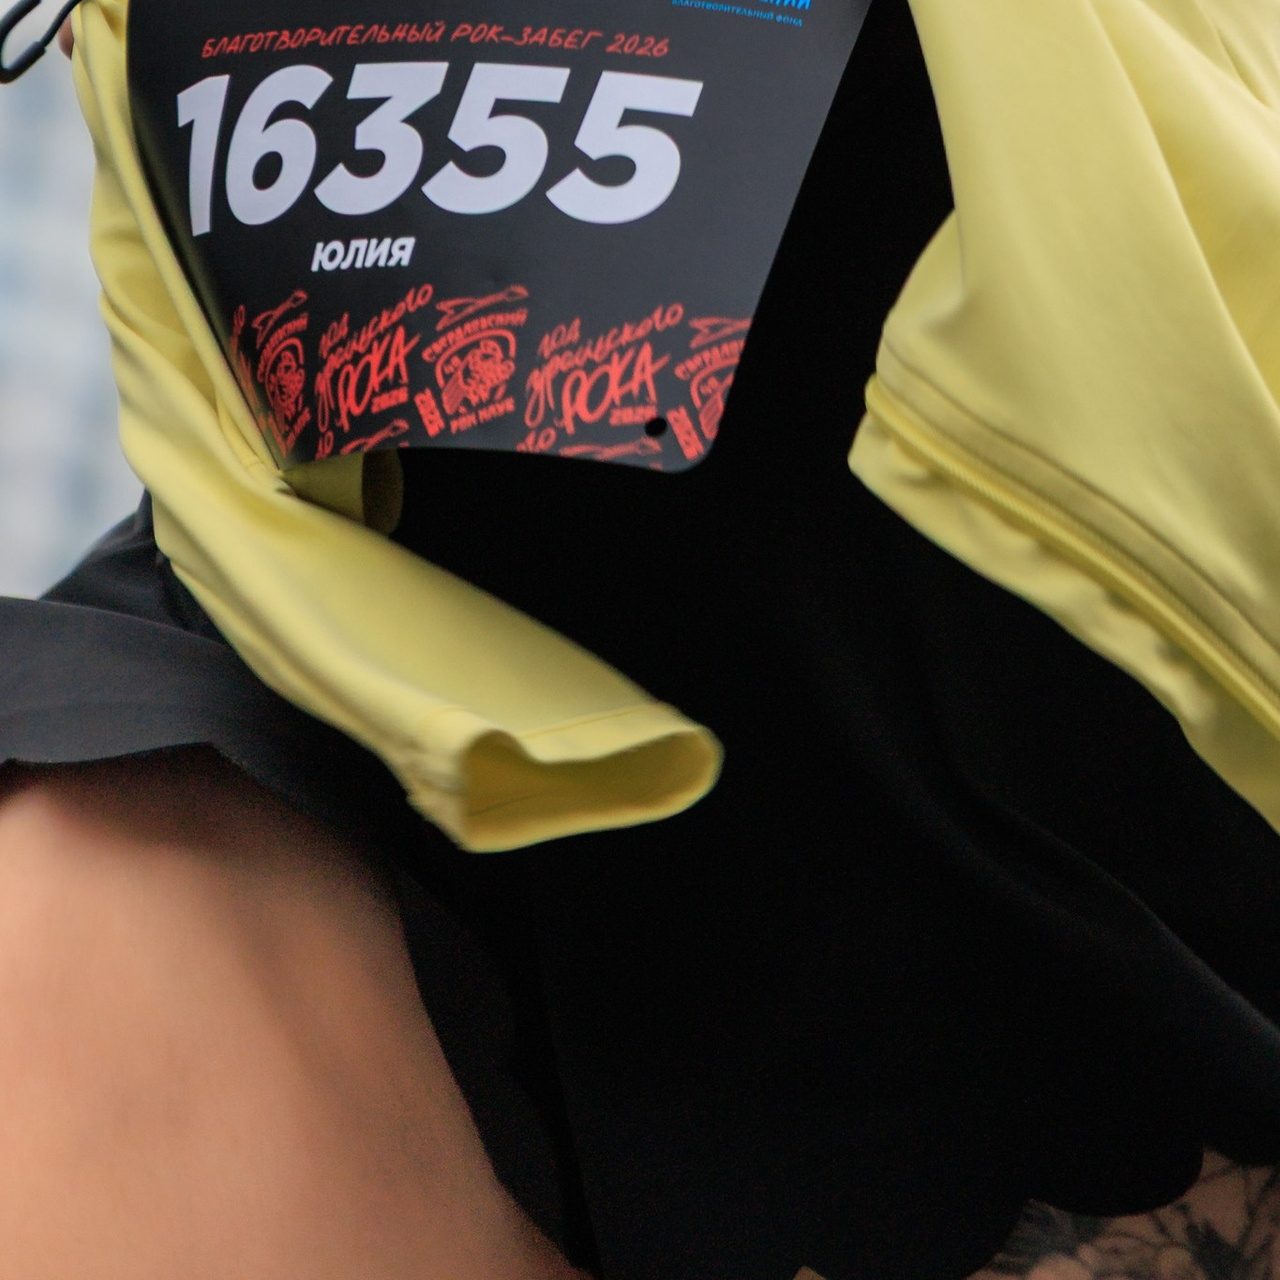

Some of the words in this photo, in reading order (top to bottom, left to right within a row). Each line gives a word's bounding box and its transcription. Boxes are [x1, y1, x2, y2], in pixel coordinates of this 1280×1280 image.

[201, 19, 446, 59] БЛАГОТВОРИТЕЛЬНЫЙ
[451, 22, 603, 51] РОК-ЗАБЕГ
[605, 33, 669, 58] 2026
[775, 13, 803, 28] ФОНД
[176, 61, 704, 237] 16355
[310, 236, 416, 273] ЮЛИЯ
